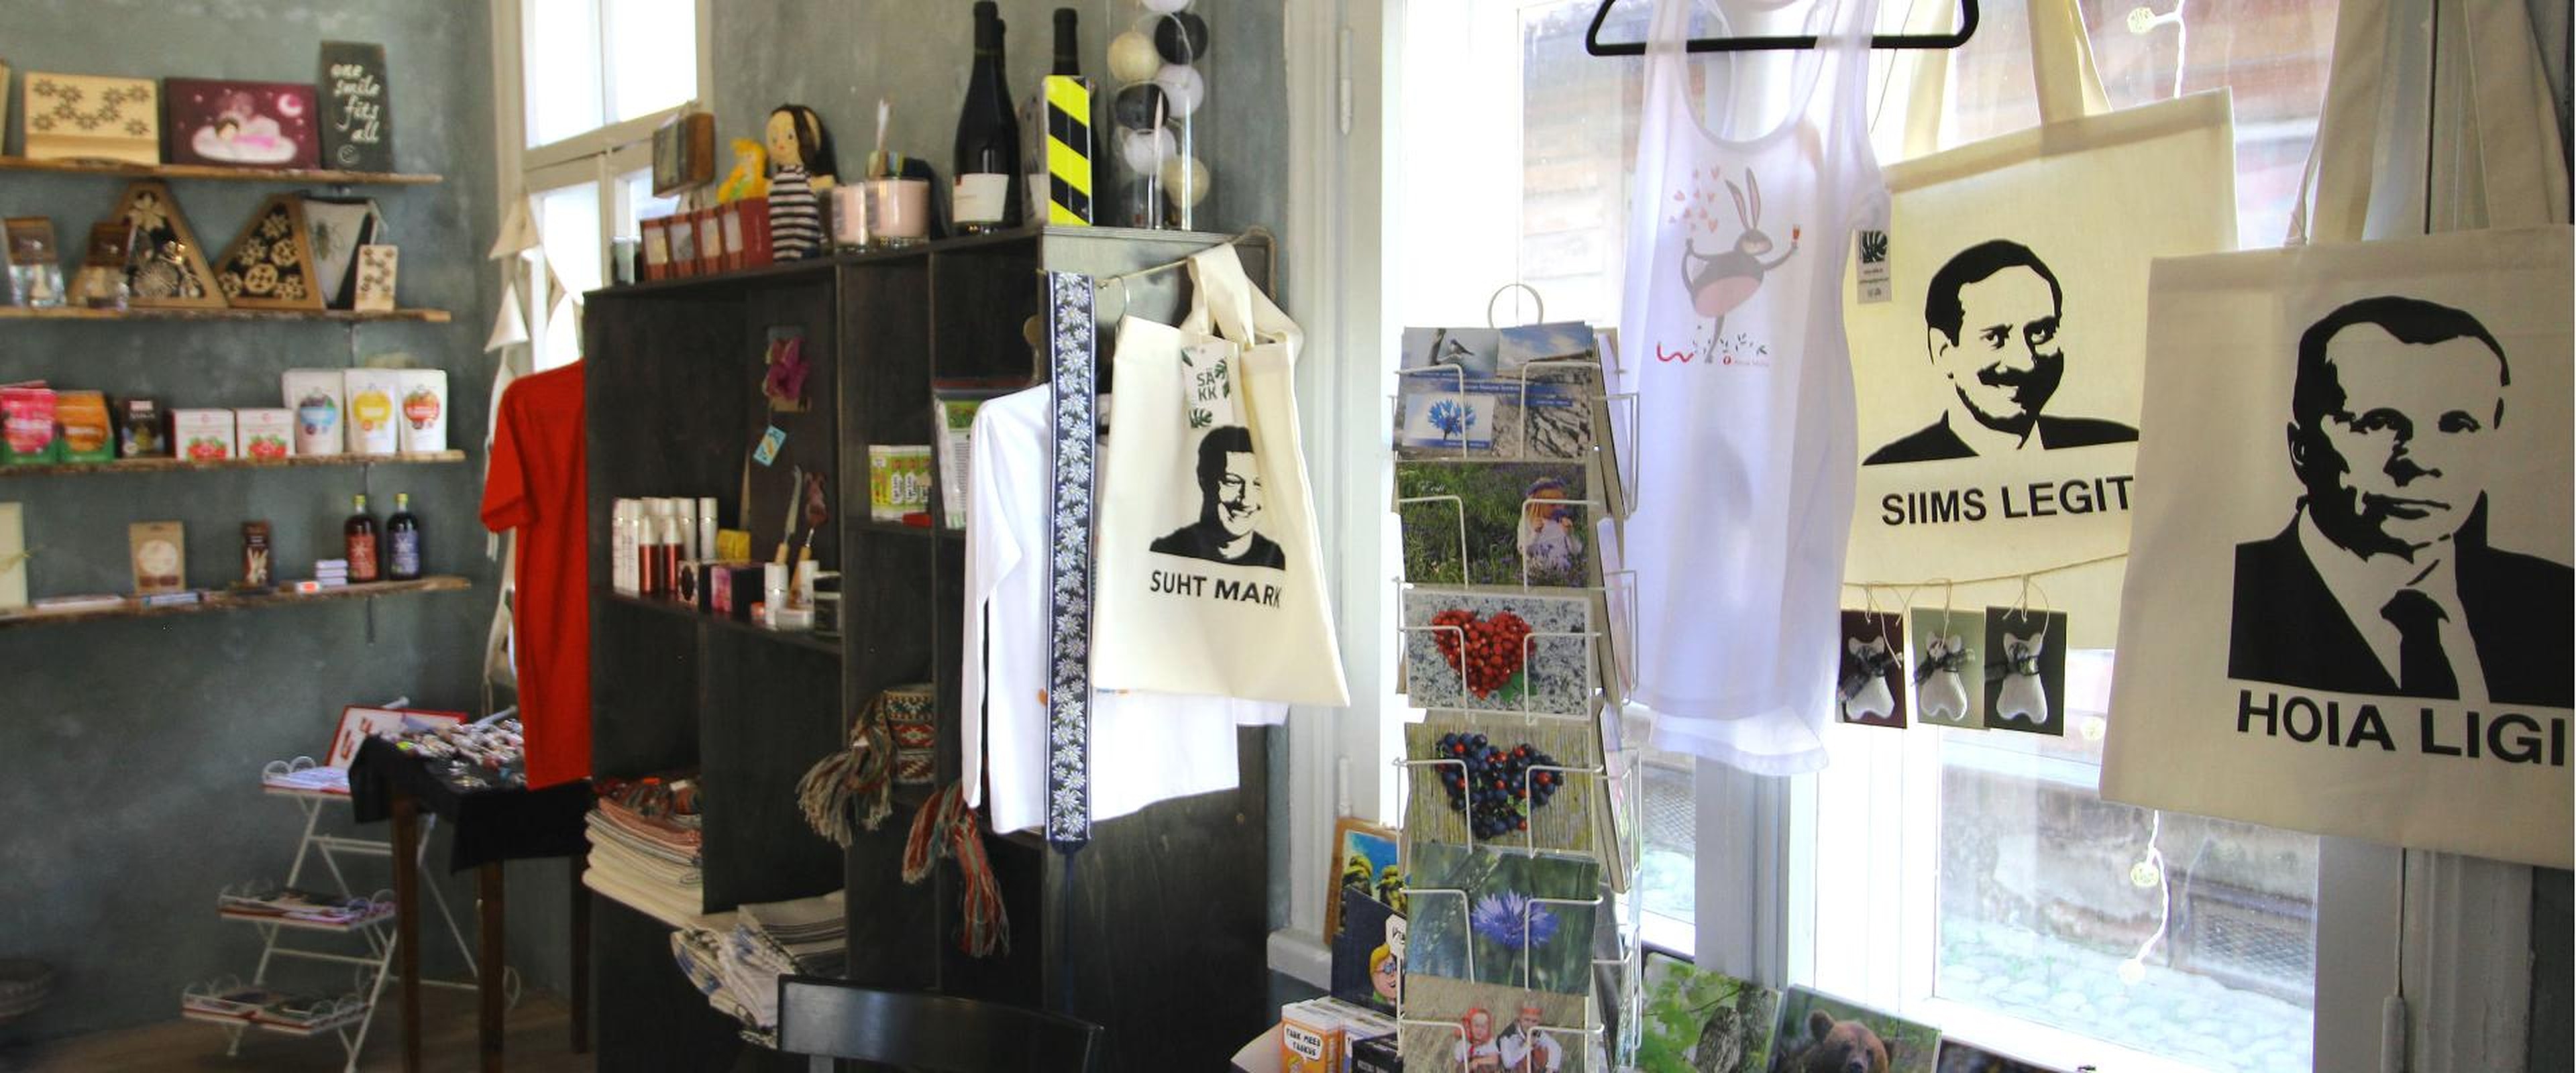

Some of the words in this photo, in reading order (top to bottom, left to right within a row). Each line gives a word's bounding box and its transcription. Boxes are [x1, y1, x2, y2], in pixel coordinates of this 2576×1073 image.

[333, 74, 381, 97] smile
[335, 94, 380, 131] fits
[351, 119, 380, 144] all
[1197, 386, 1218, 402] KK
[1881, 487, 1988, 526] SIIMS
[2001, 475, 2135, 520] LEGIT
[1150, 570, 1208, 598] SUHT
[1214, 578, 1282, 610] MARK
[2237, 689, 2397, 752] HOIA
[2420, 707, 2567, 767] LIGI
